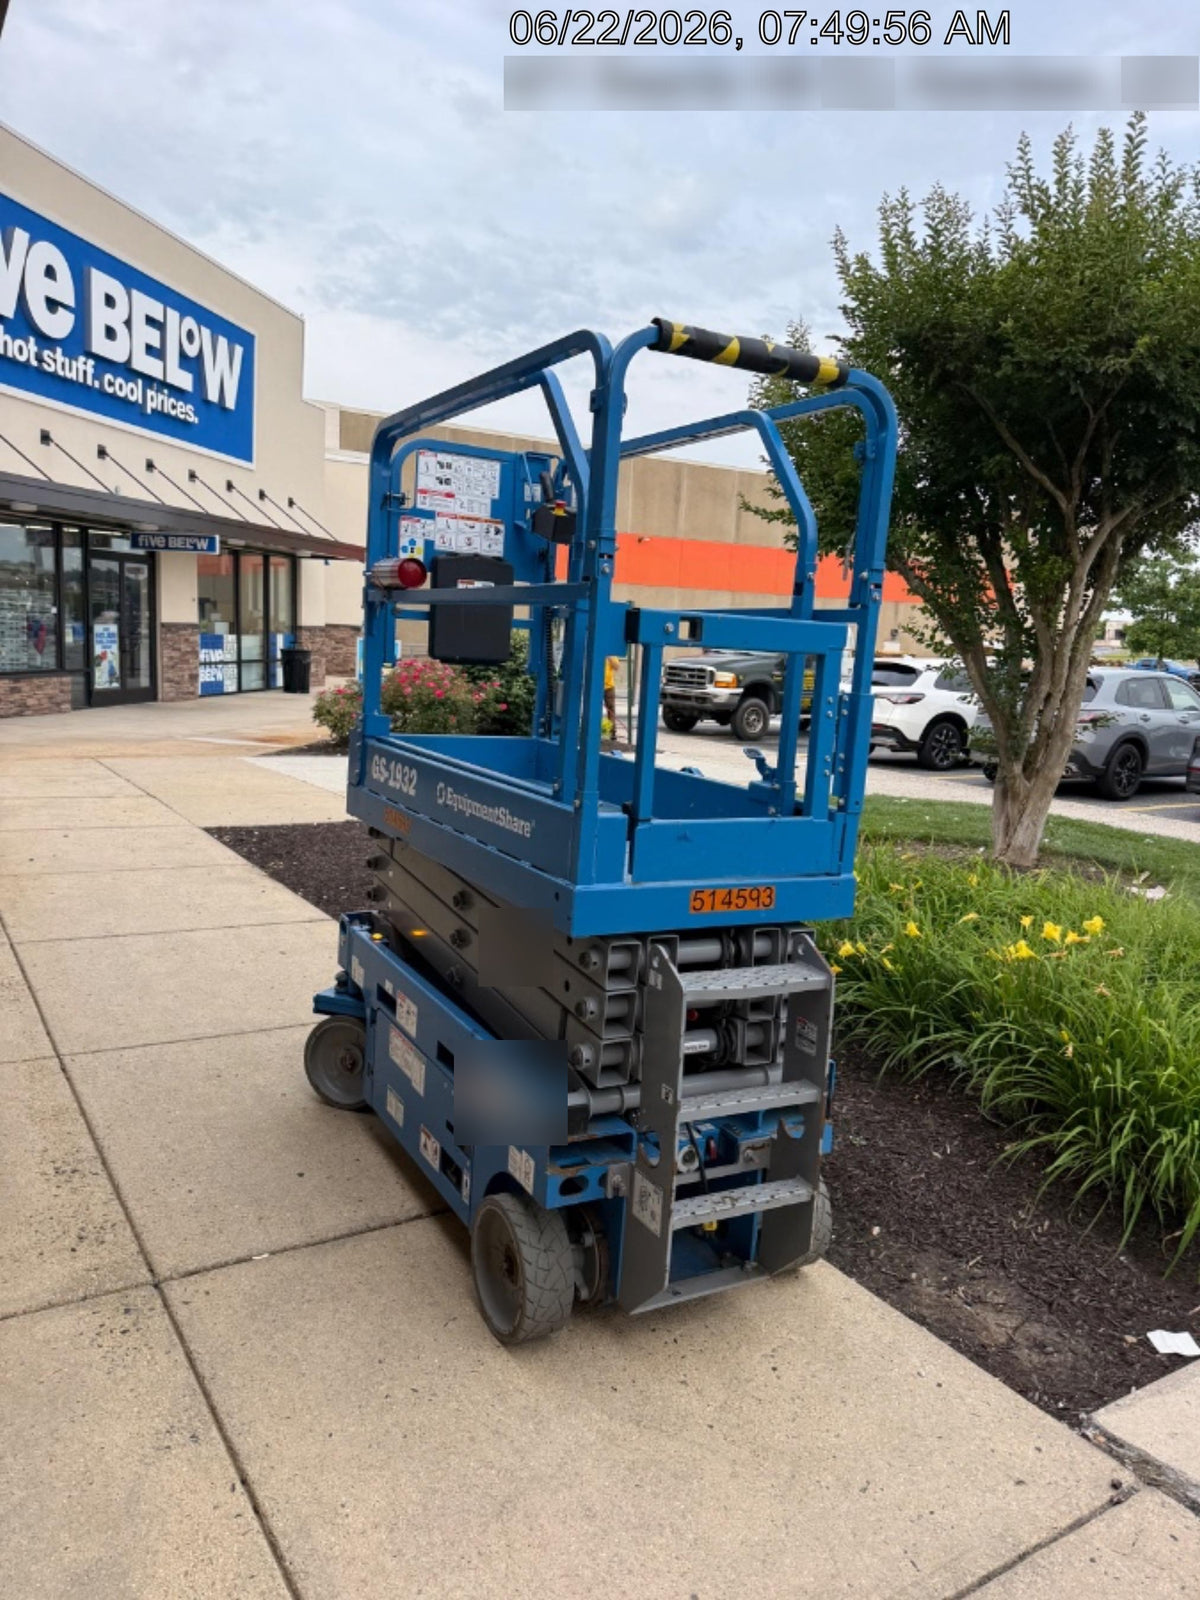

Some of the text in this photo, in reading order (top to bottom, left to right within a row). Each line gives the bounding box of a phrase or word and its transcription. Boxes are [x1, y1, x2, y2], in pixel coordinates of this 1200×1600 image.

[0, 226, 76, 339] ve
[0, 324, 199, 424] hot stuff. cool prices.
[138, 534, 166, 548] five
[371, 755, 418, 796] GS-1932
[692, 886, 774, 912] 514593
